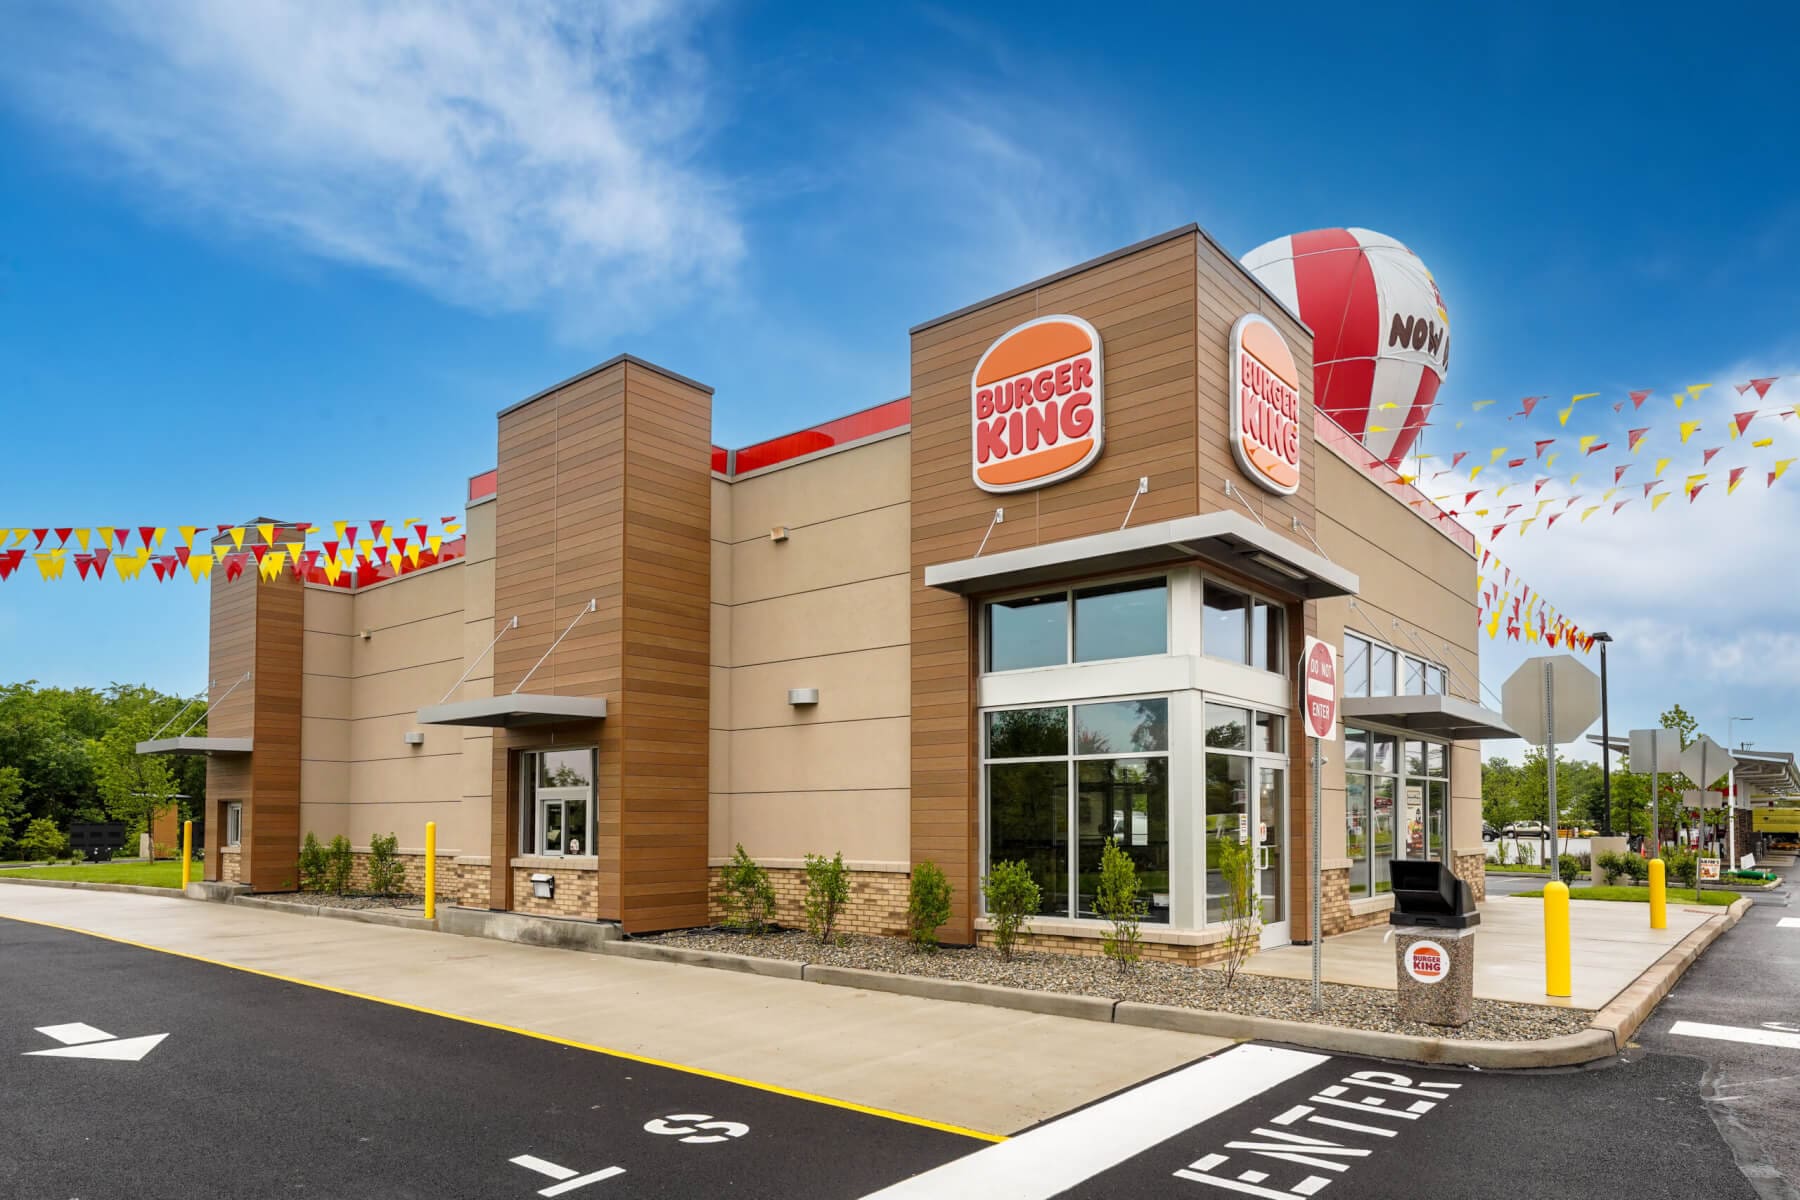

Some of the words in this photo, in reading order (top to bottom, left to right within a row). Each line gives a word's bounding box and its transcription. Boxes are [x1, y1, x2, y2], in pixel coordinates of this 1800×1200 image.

[1388, 312, 1443, 356] NOW
[976, 357, 1094, 420] BURGER
[1241, 352, 1298, 424] BURGER
[976, 392, 1094, 464] KING
[1241, 387, 1299, 466] KING
[1310, 658, 1319, 675] DO
[1321, 662, 1332, 678] NOT
[1312, 701, 1330, 720] ENTER
[1413, 955, 1441, 963] BURGER
[1413, 962, 1441, 972] KING
[1172, 1070, 1462, 1200] ENTER
